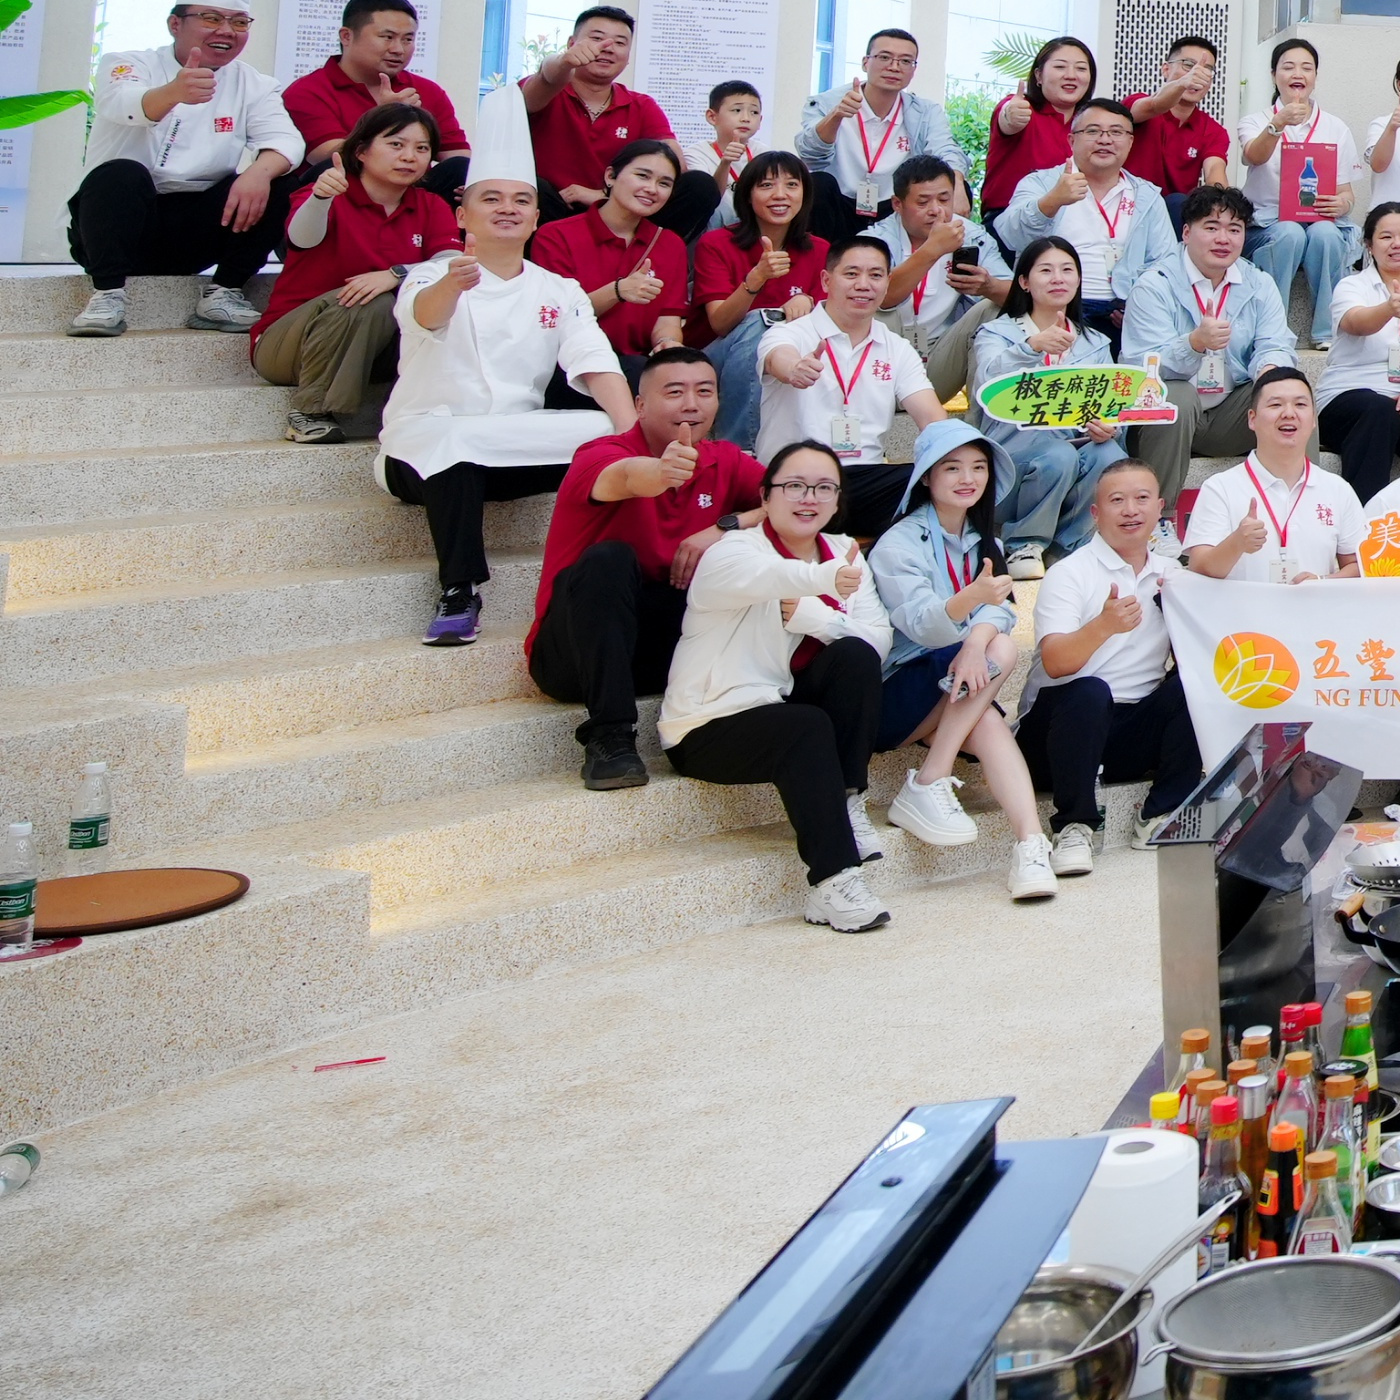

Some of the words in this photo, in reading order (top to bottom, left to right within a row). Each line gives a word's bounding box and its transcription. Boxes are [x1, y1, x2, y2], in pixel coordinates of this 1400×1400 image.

[1012, 371, 1110, 401] 椒香麻韵
[1021, 397, 1127, 429] 五丰黎红
[1315, 688, 1350, 708] NG
